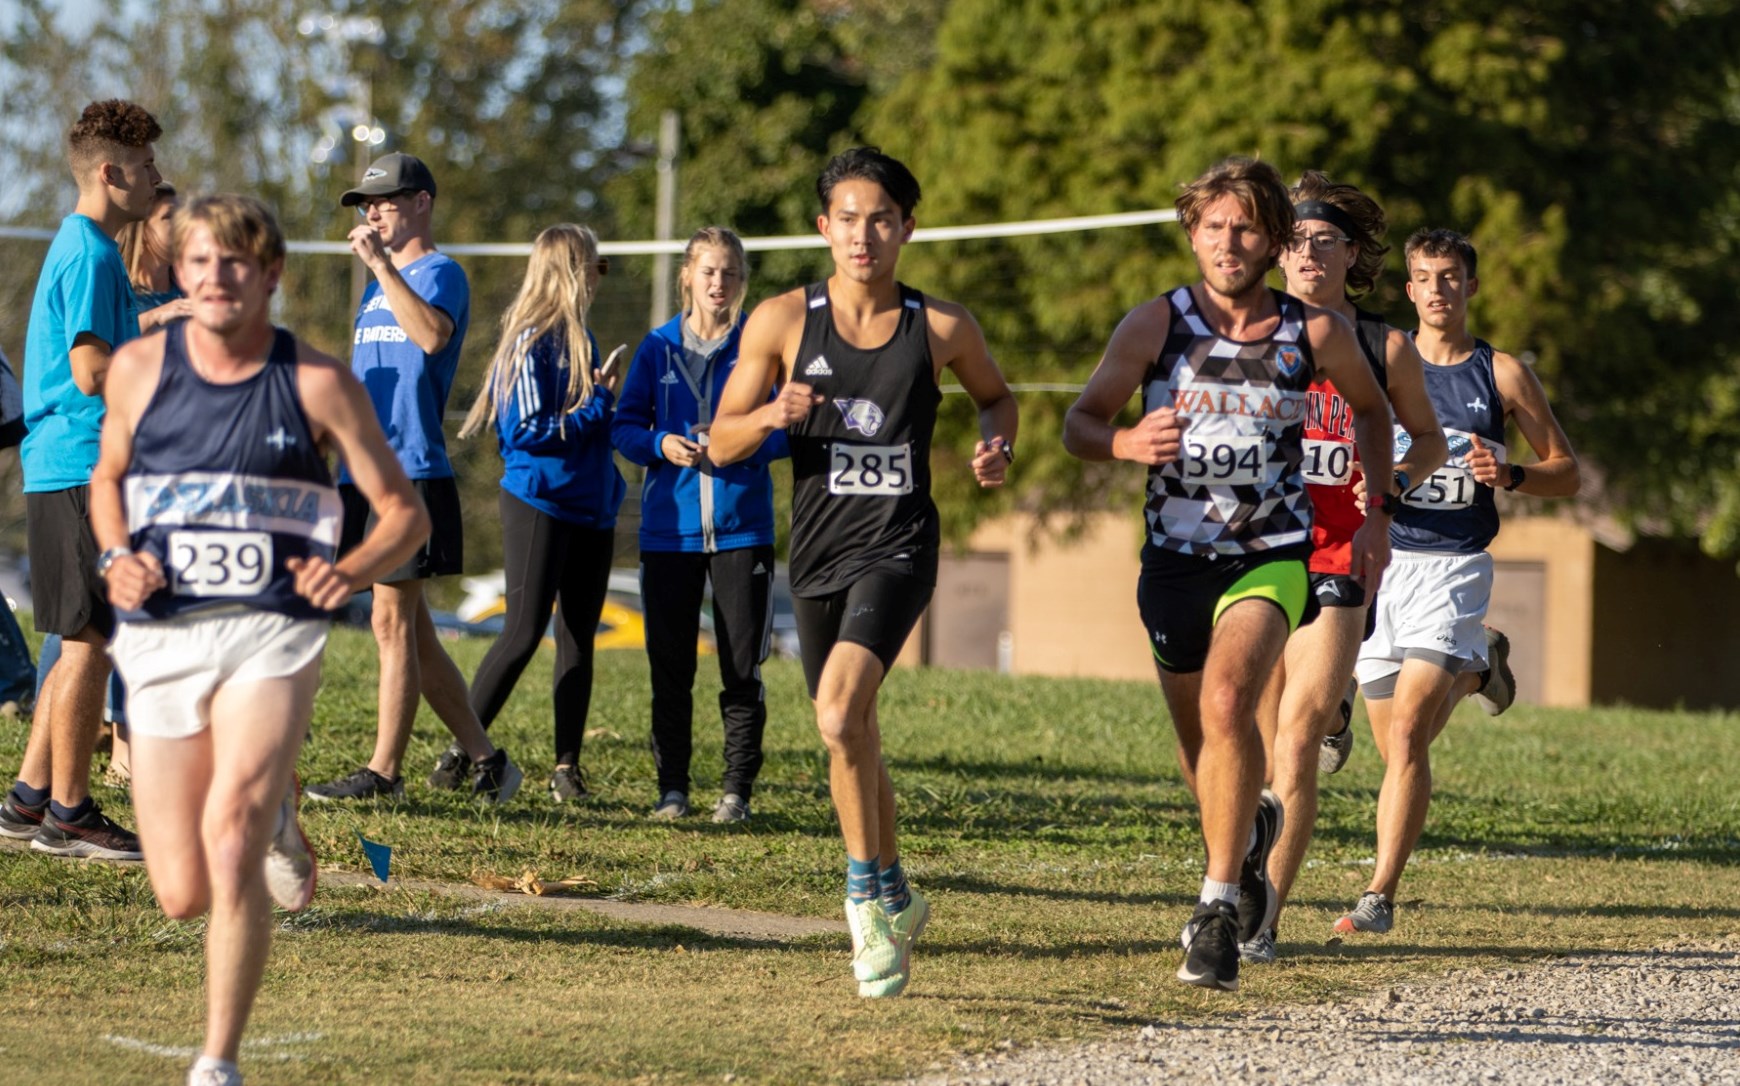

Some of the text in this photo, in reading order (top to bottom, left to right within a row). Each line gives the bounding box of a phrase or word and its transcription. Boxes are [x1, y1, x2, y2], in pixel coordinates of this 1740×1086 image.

[834, 452, 907, 488] 285
[1188, 443, 1263, 480] 394
[178, 543, 266, 586] 239
